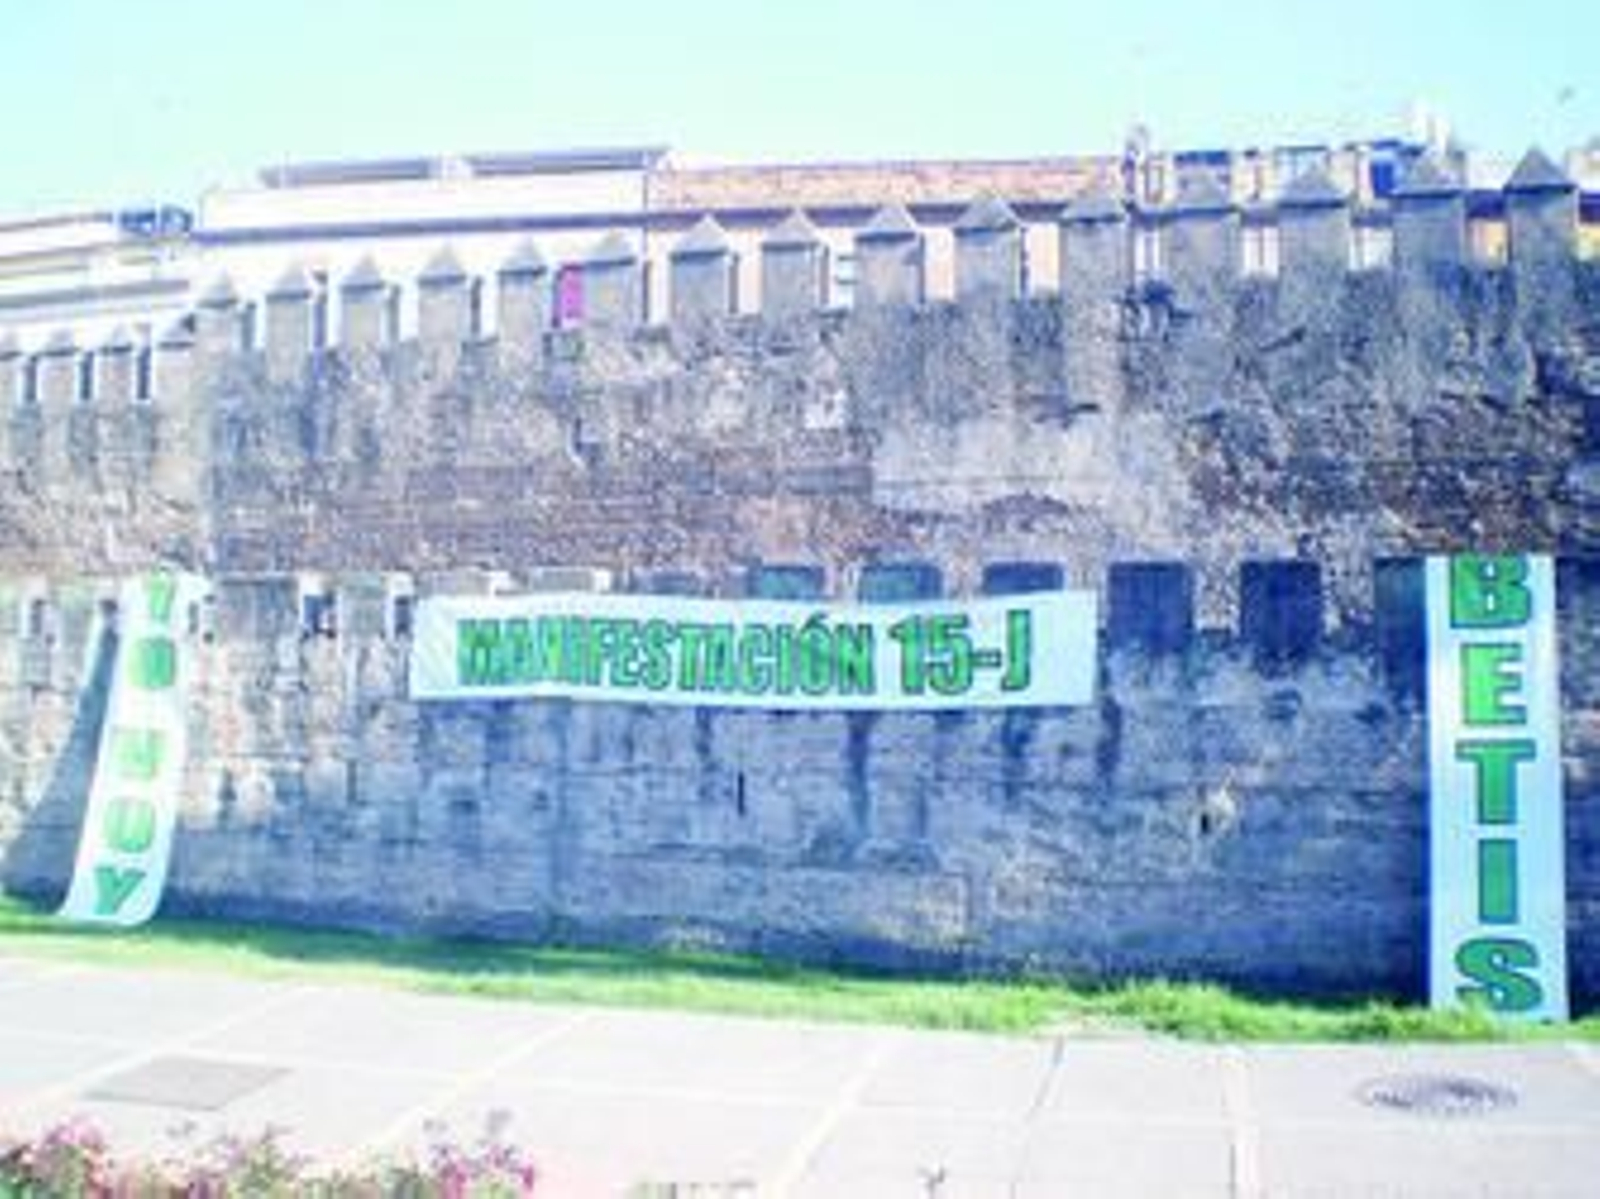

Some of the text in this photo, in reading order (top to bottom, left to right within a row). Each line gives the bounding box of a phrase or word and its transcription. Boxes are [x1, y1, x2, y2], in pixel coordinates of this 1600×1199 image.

[457, 609, 1031, 696] MANIFESTACIÓN 15-J
[1449, 552, 1543, 1012] BETIS
